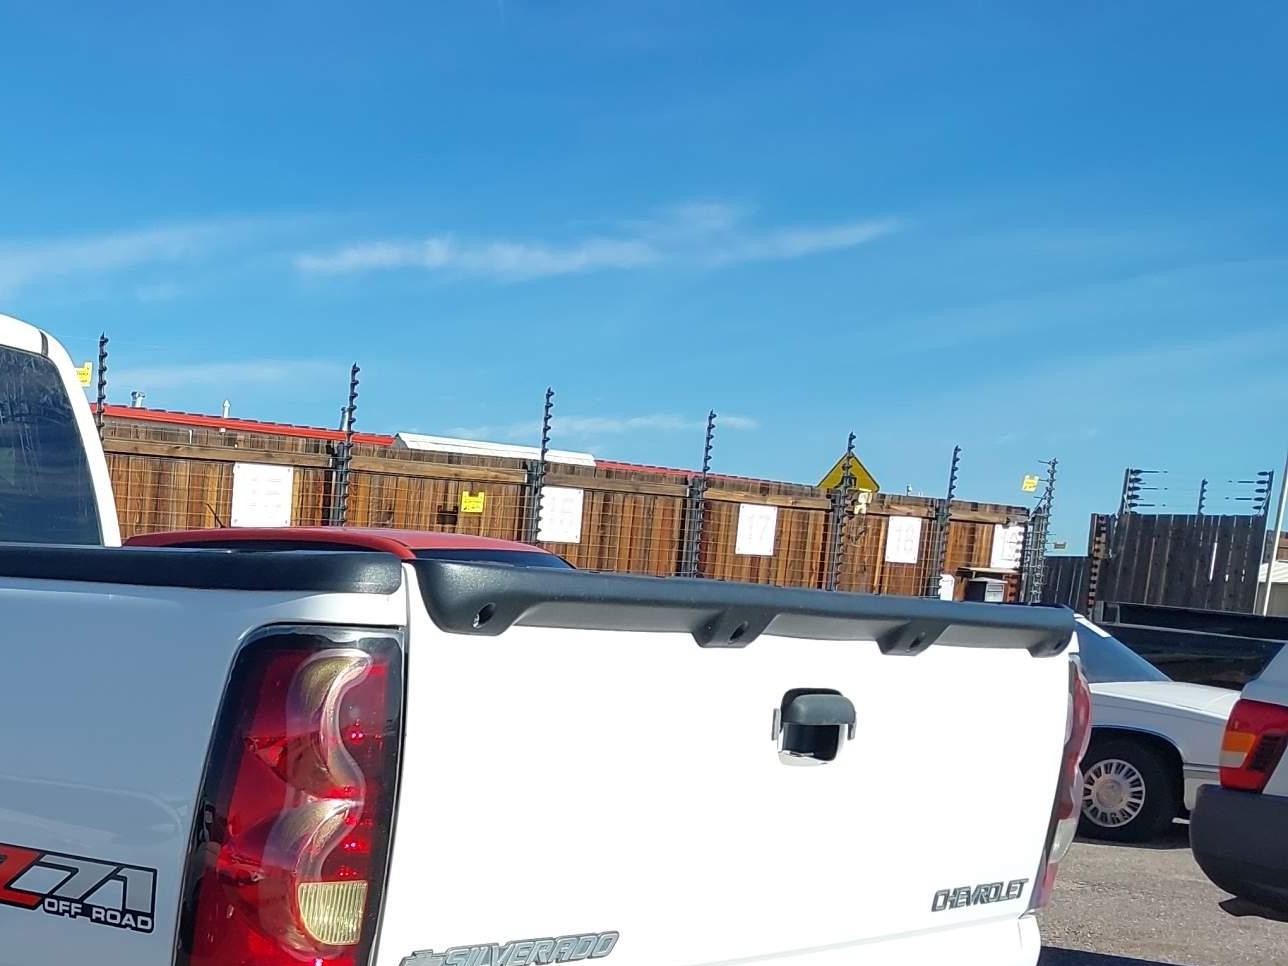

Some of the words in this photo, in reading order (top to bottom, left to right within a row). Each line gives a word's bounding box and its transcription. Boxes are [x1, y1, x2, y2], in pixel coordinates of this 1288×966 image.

[931, 878, 1030, 913] CHEVROLET
[44, 898, 83, 917] OFF
[91, 907, 153, 931] ROAD
